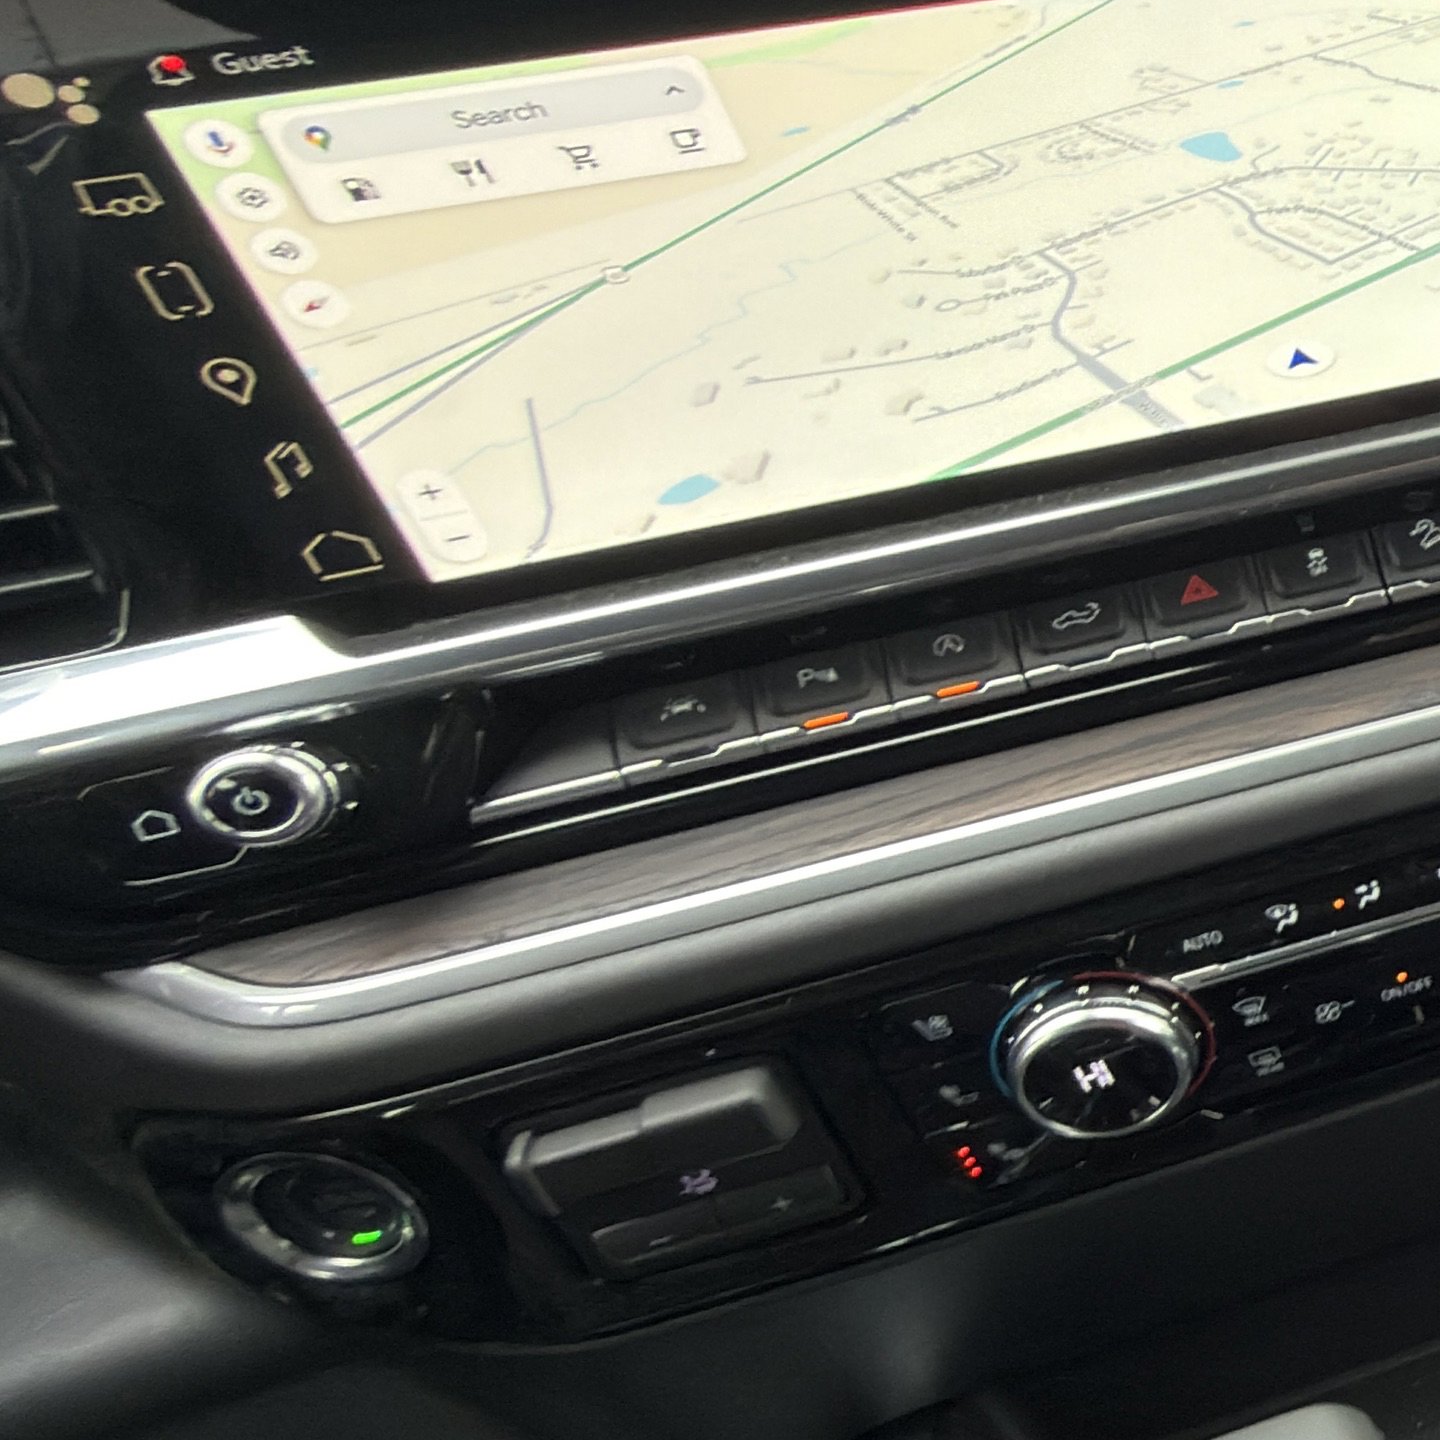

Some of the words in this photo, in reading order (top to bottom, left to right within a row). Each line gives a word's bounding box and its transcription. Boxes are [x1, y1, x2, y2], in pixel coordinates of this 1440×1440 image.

[211, 43, 313, 76] Guest
[451, 100, 547, 132] Search
[1182, 930, 1222, 952] AUTO
[1380, 976, 1431, 1001] ON/OFF
[1074, 1059, 1114, 1095] HI
